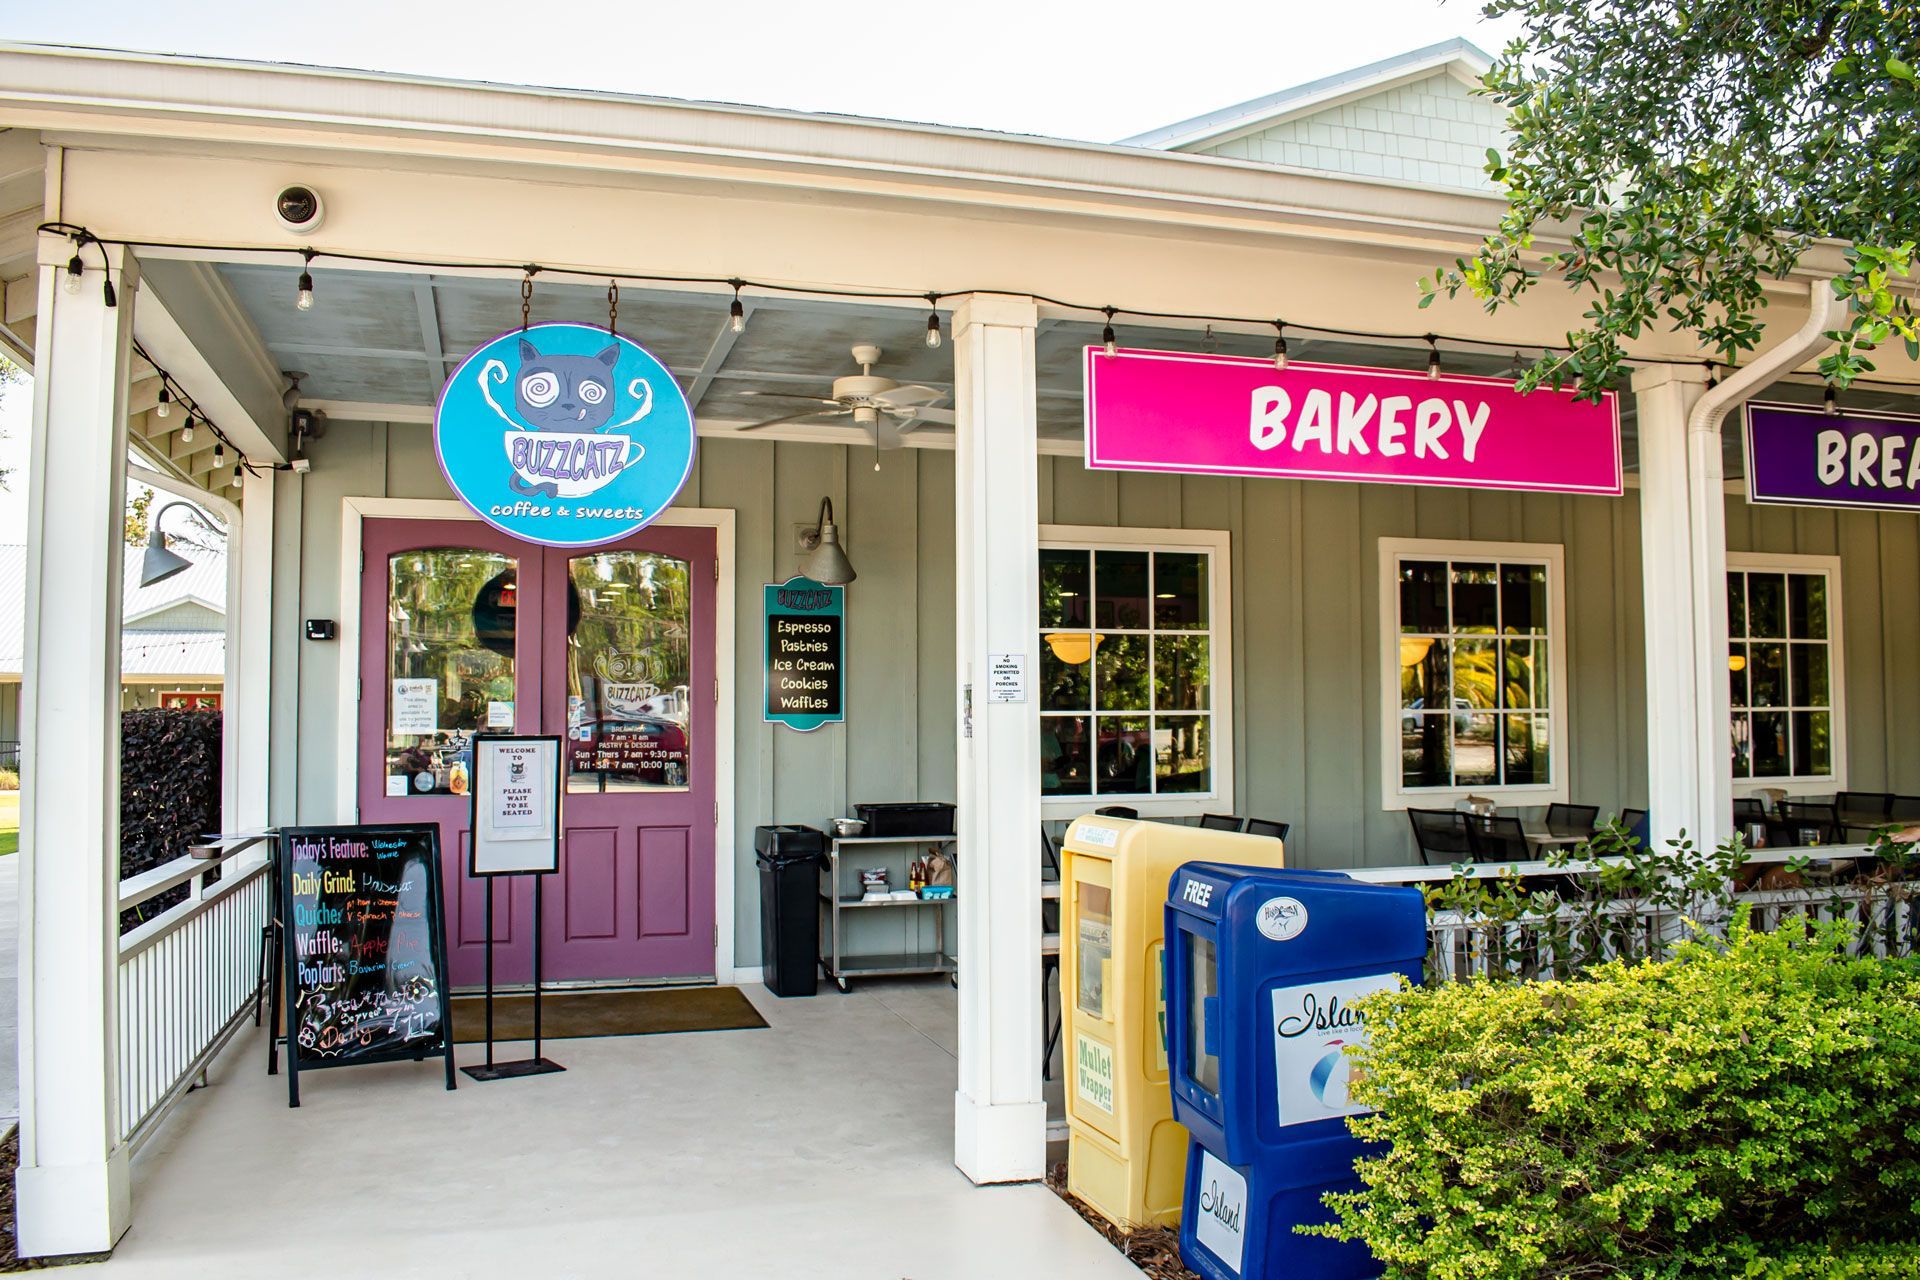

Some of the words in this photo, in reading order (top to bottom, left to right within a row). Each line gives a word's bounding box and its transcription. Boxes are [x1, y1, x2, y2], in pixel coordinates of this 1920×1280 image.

[1249, 385, 1491, 463] BAKERY
[512, 437, 624, 481] BUZZCATZ
[490, 501, 552, 517] coffee
[557, 506, 570, 516] &
[576, 506, 644, 519] sweets
[501, 591, 515, 605] EX
[777, 589, 832, 611] BUZZCATZ
[777, 620, 831, 636] Espresso
[781, 639, 828, 653] Pastries
[774, 659, 792, 671] Ice
[796, 658, 834, 671] Cream
[607, 686, 653, 703] BUZZCATZ
[780, 677, 828, 690] Cookies
[780, 696, 828, 709] Waffles
[579, 761, 590, 769] Fri
[597, 761, 610, 769] Sat
[614, 761, 619, 769] 7
[640, 761, 663, 769] 10:00
[664, 762, 677, 770] pm
[597, 751, 619, 759] Thurs
[669, 752, 682, 760] pm
[291, 837, 327, 865] Today's
[330, 837, 369, 859] Feature:
[293, 871, 321, 900] Daily
[324, 870, 356, 894] Grind:
[1183, 879, 1213, 908] FREE
[295, 902, 342, 926] Quiche:
[297, 930, 343, 956] Waffle:
[350, 934, 389, 958] Apple
[298, 960, 346, 990] PopTarts:
[1278, 993, 1366, 1038] Islan
[320, 1021, 381, 1048] Daily
[1079, 1039, 1112, 1080] Mullet
[1079, 1067, 1112, 1103] Wrapper
[1201, 1179, 1241, 1233] Island
